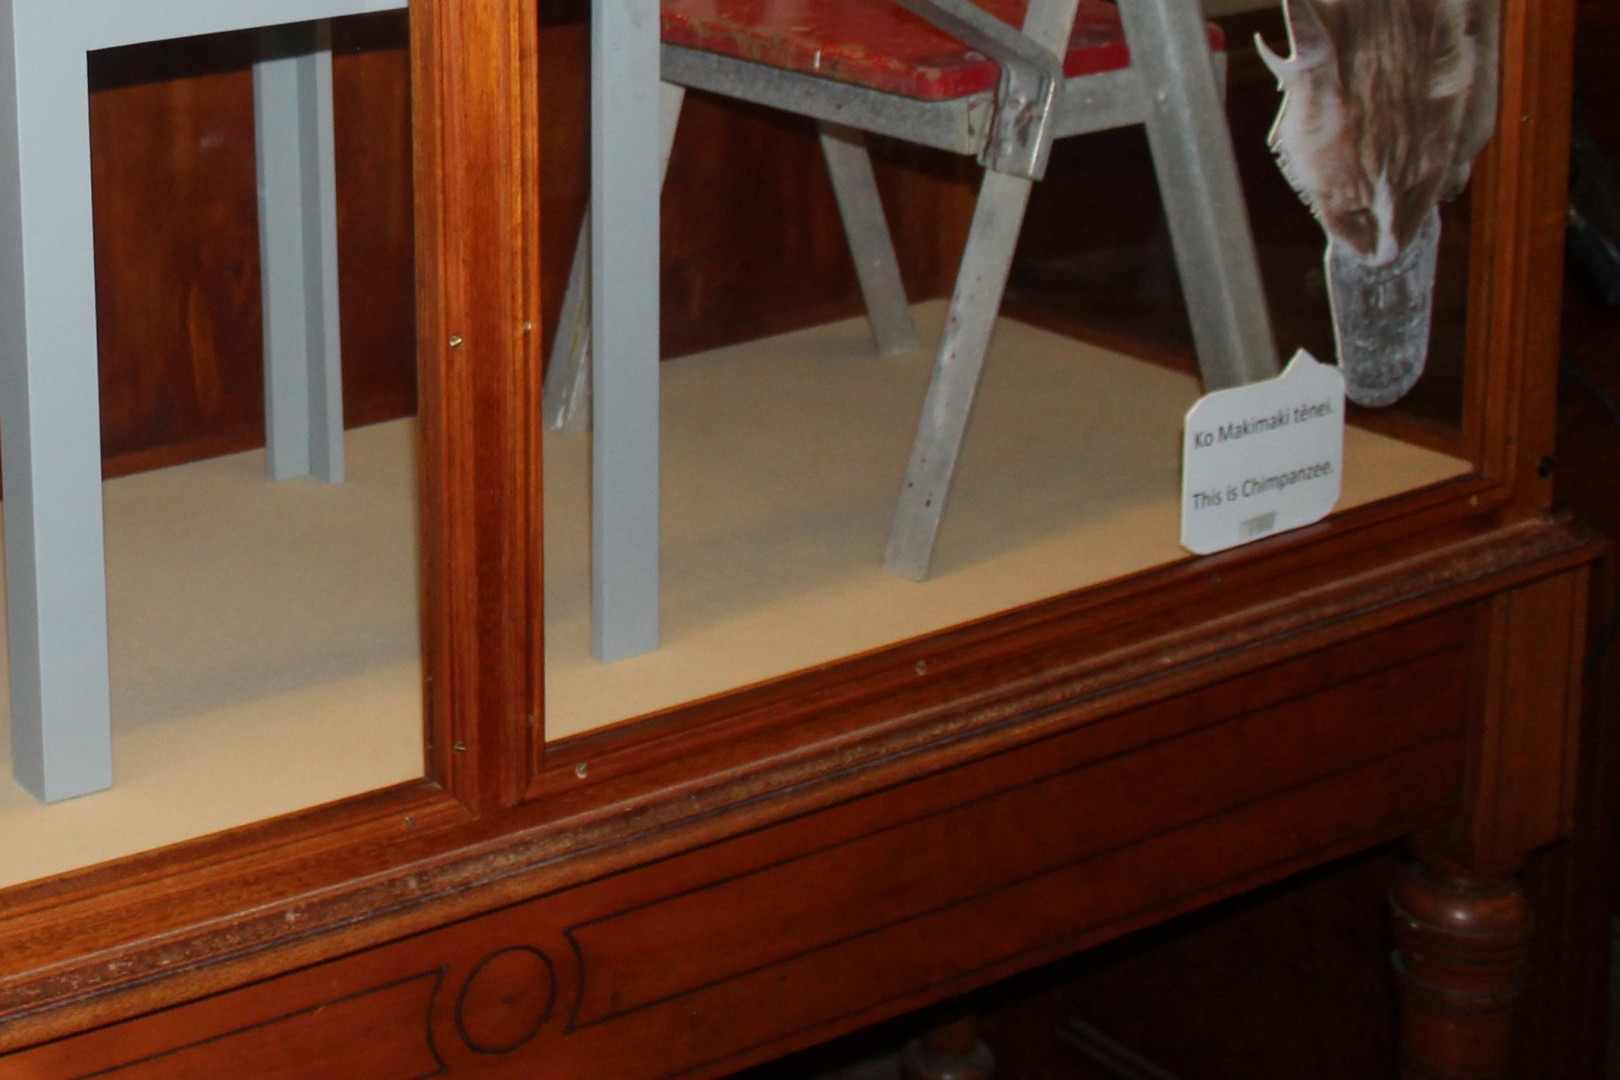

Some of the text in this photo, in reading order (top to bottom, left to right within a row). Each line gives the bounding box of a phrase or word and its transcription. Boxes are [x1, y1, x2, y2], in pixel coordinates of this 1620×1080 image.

[1193, 430, 1215, 450] Ko
[1218, 408, 1291, 443] Makimaki
[1192, 460, 1334, 512] This is Chimpanzee.
